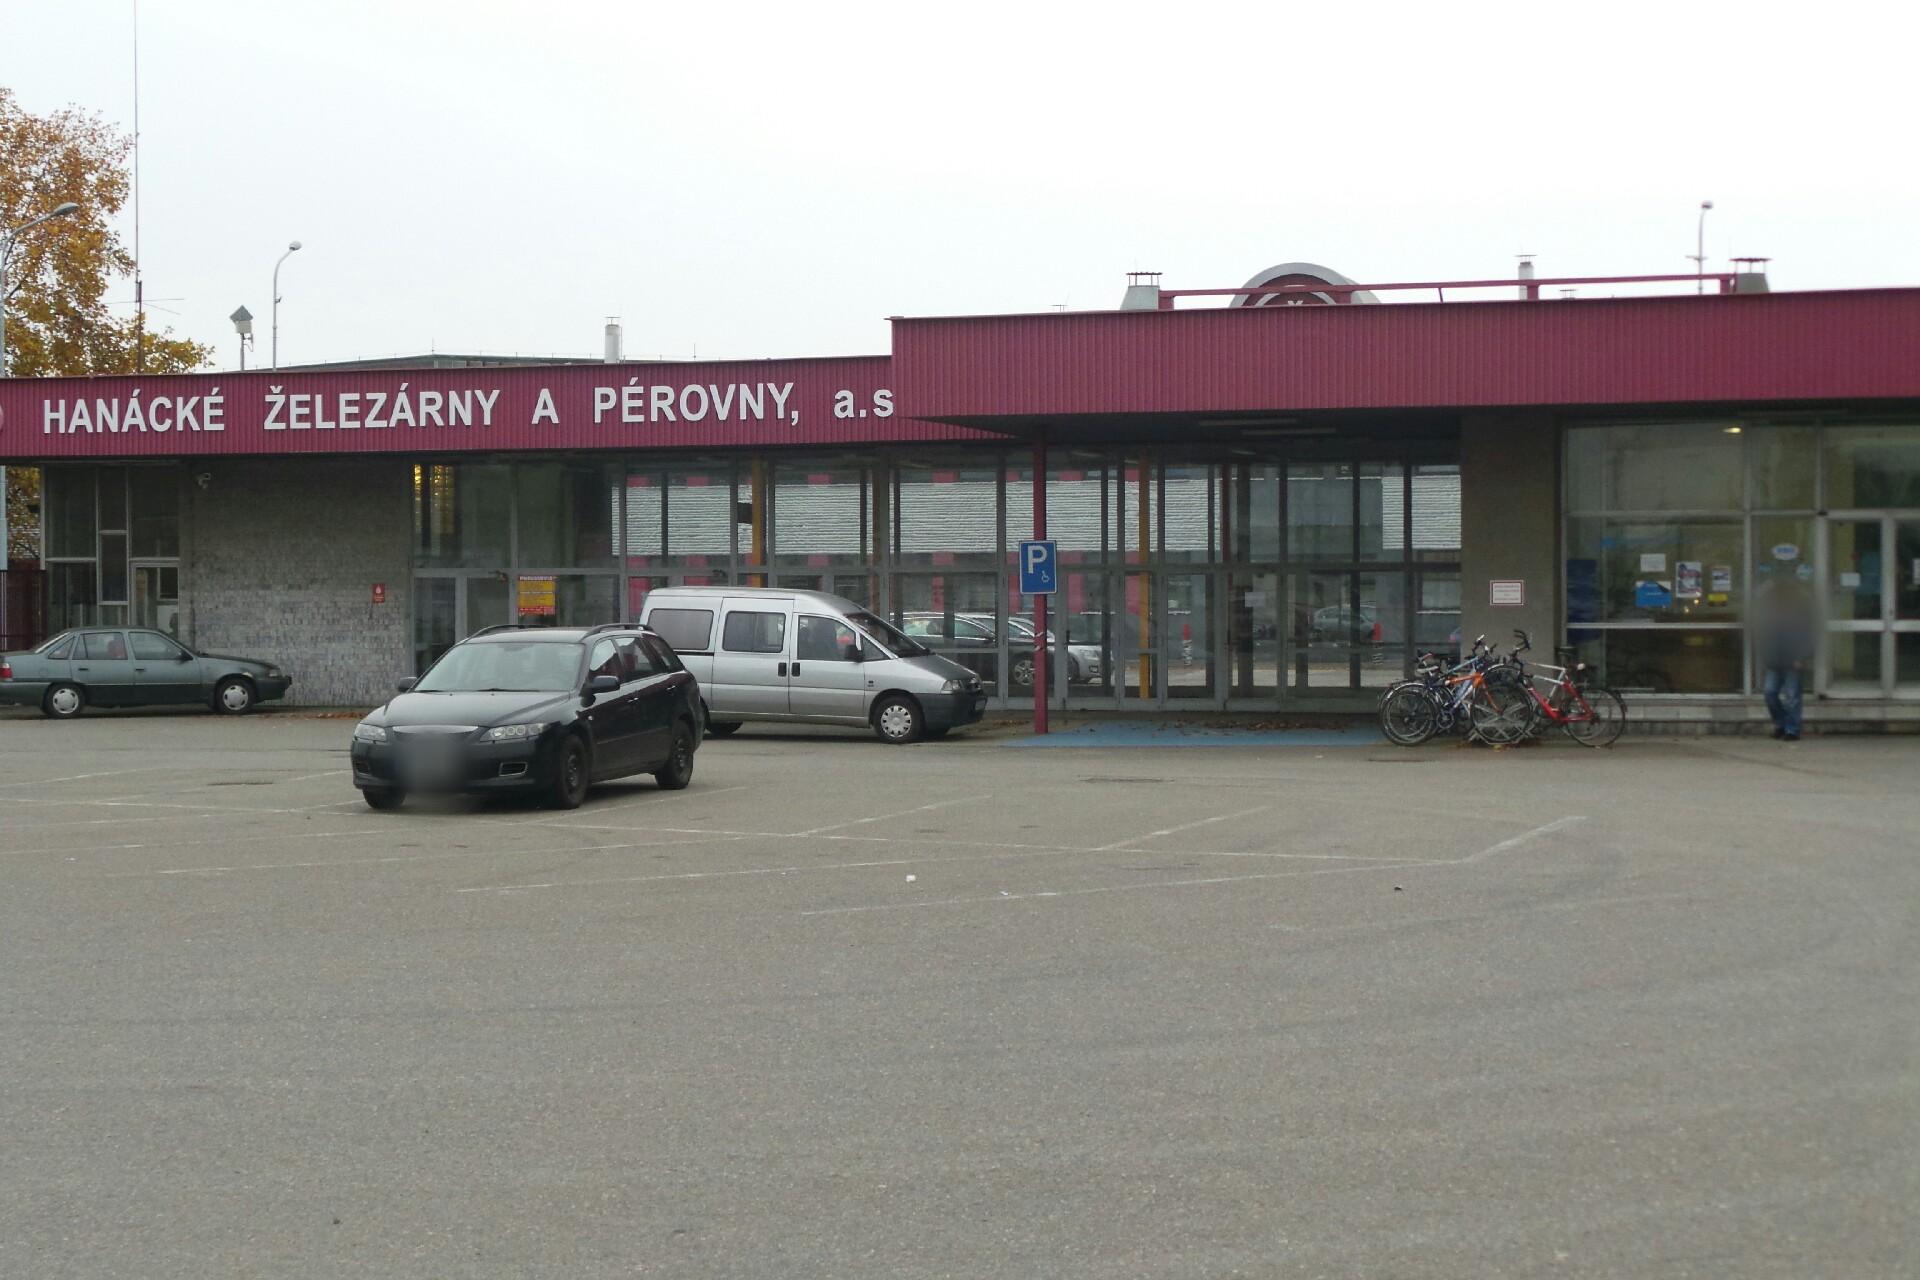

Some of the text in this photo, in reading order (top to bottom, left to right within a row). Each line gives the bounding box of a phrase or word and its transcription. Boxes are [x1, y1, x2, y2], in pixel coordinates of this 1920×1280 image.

[43, 386, 225, 434] HANÁCKÉ
[264, 383, 501, 431] ŽELEZÁRNY
[531, 389, 560, 425] A
[595, 376, 799, 426] PÉROVNY,
[1027, 545, 1048, 574] P
